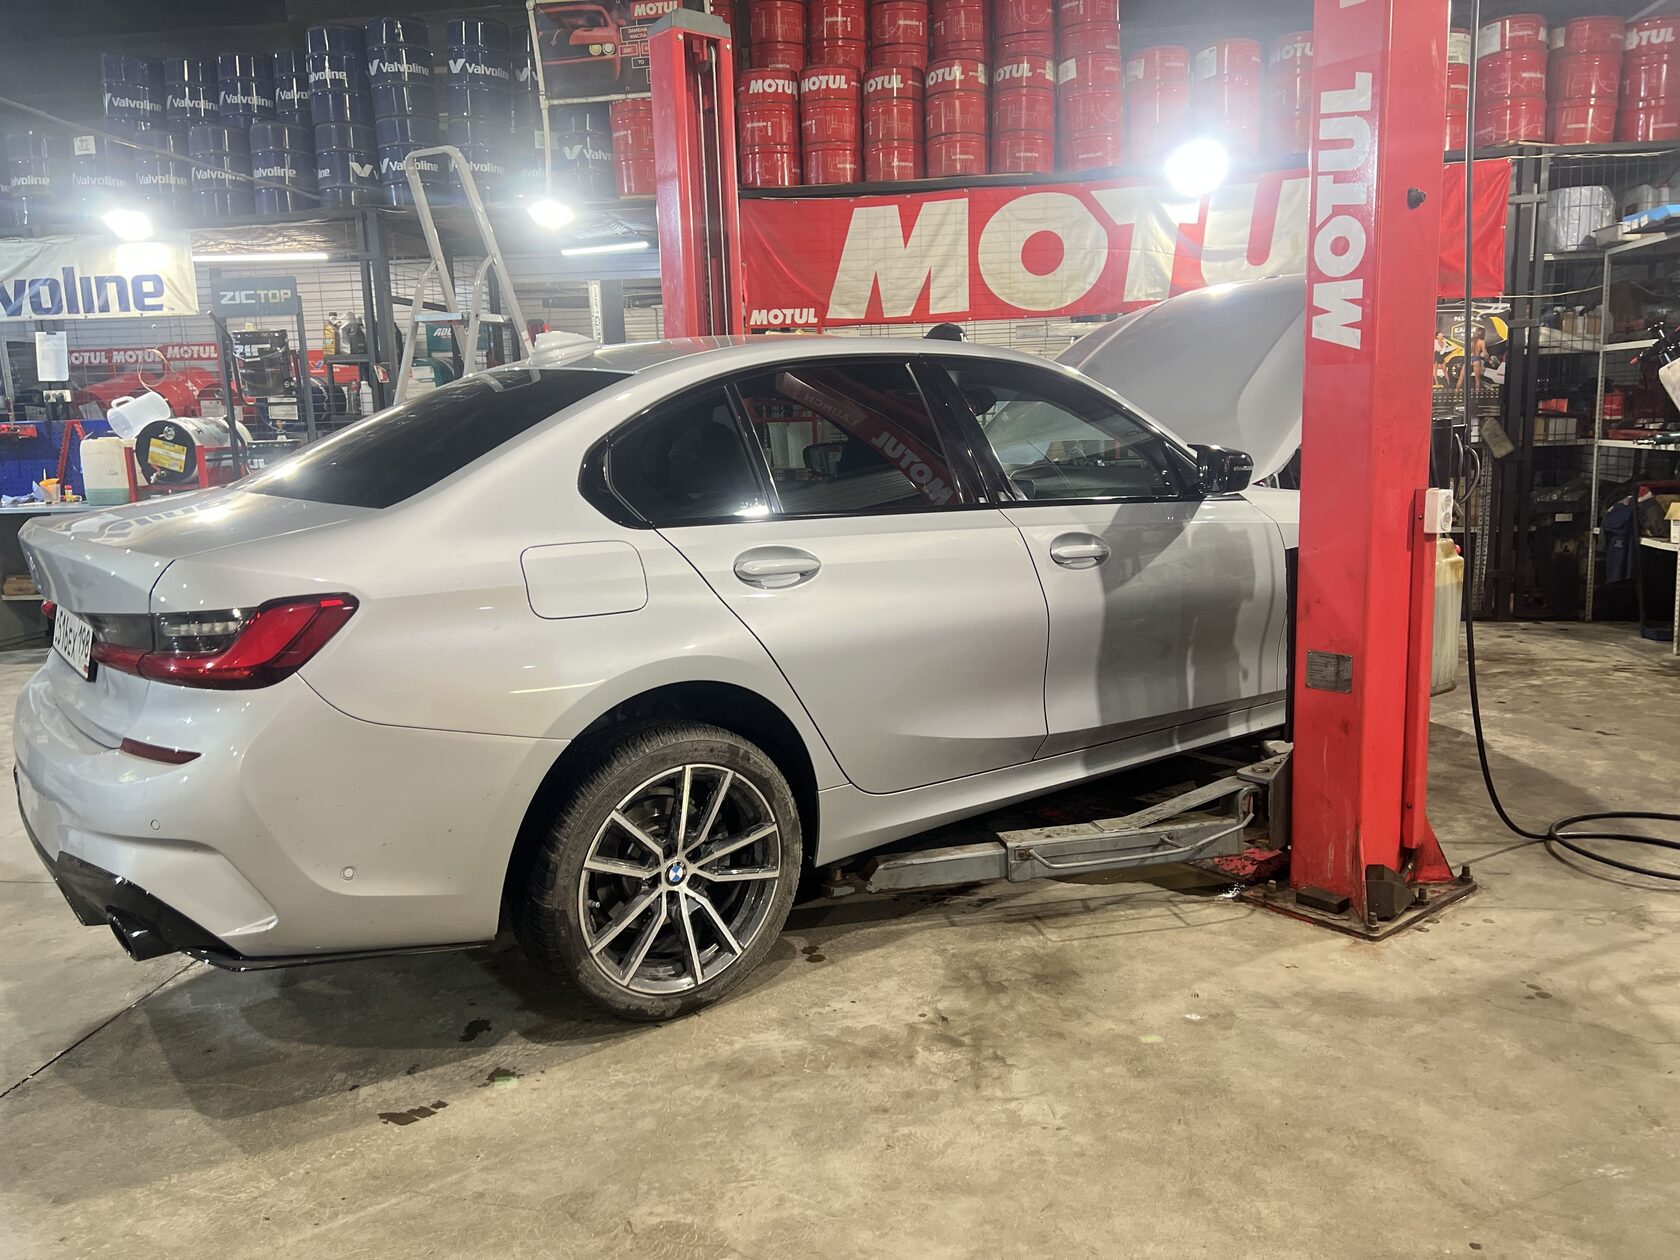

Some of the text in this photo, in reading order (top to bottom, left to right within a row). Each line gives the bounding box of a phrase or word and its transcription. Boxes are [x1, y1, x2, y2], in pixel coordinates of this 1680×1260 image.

[379, 61, 430, 76] Valvoline
[801, 75, 848, 94] MOTUL
[389, 159, 439, 171] Valoline
[1312, 72, 1373, 350] MOTUL
[219, 289, 291, 304] ZIC TOP
[750, 307, 819, 325] MOTUL
[112, 351, 161, 363] MOTUL
[167, 345, 218, 358] MOTUL
